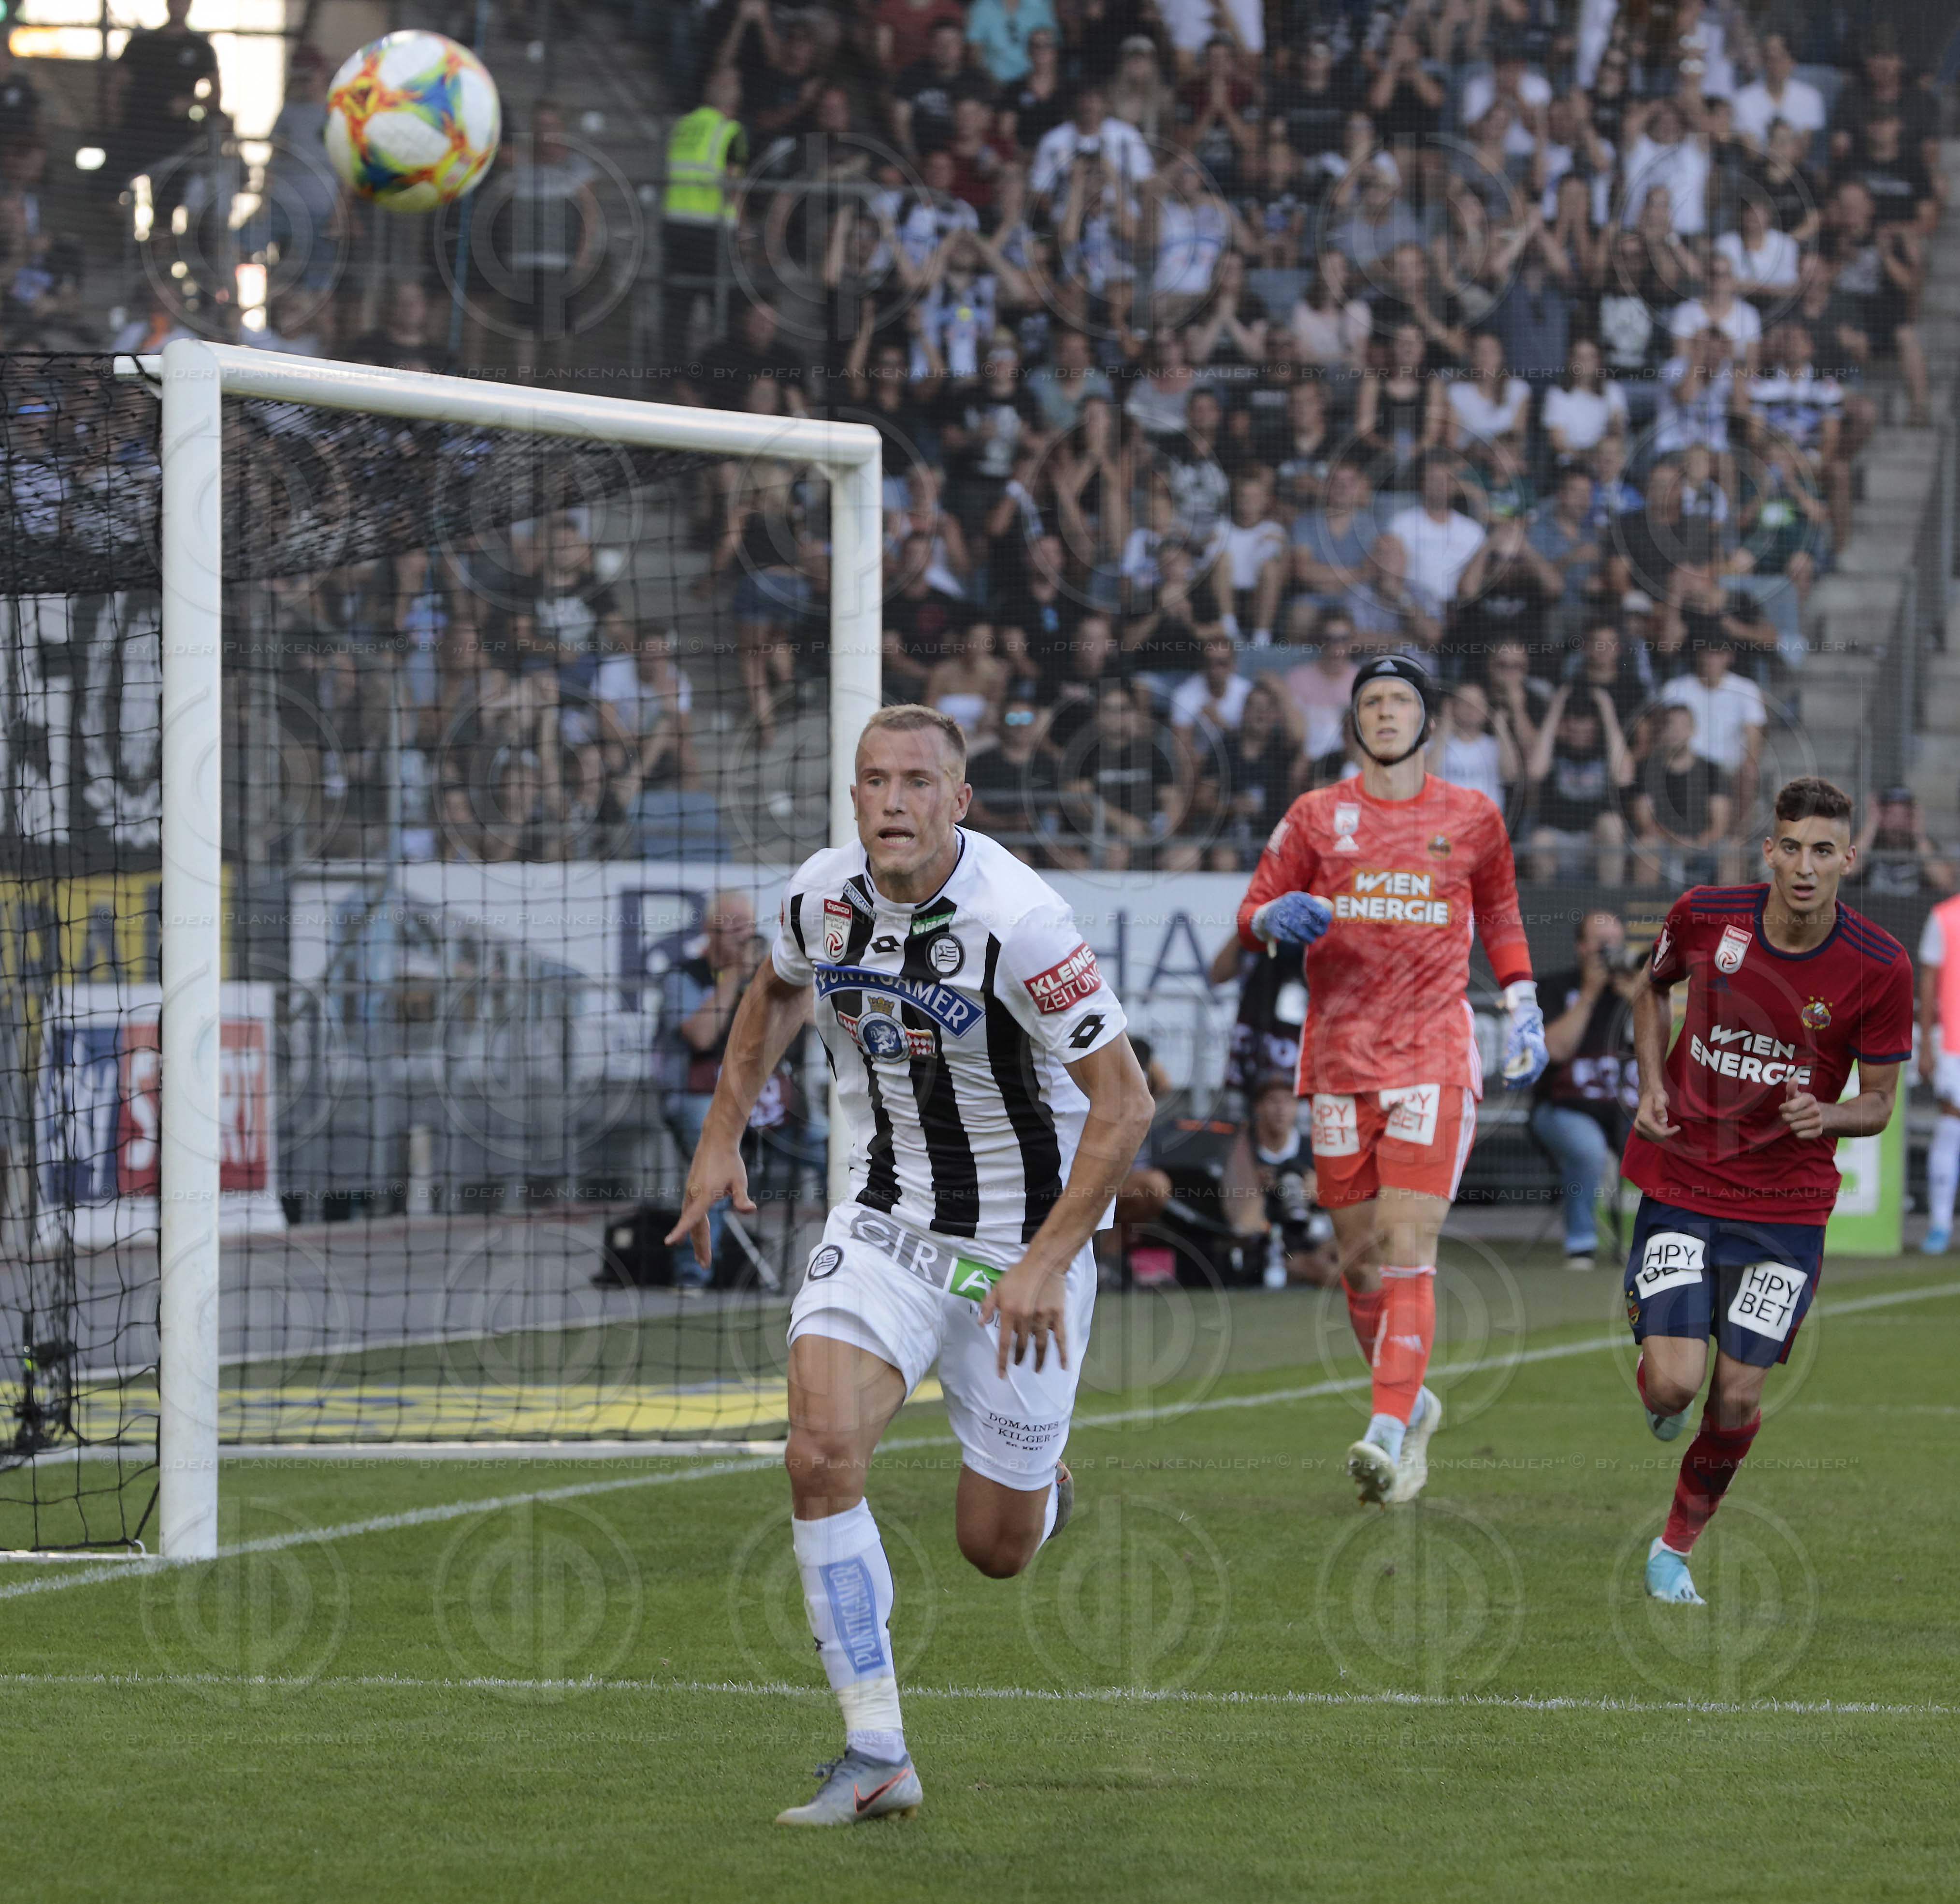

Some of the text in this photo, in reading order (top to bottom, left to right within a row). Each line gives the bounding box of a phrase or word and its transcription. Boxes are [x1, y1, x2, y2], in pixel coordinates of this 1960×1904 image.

[1355, 871, 1431, 897] WIEN
[827, 901, 850, 915] tipico
[1335, 894, 1448, 925] ENERGIE
[1030, 945, 1095, 997] KLEINE
[1710, 1024, 1796, 1061] WIEN
[1690, 1034, 1813, 1086] ENERGIE
[1645, 1244, 1697, 1266] HPY
[1748, 1266, 1801, 1304] HPY
[1738, 1292, 1791, 1327] BET
[989, 1412, 1059, 1432] DOMAINES
[997, 1427, 1051, 1443] KILGER
[828, 1563, 881, 1668] PUNTIGAMER
